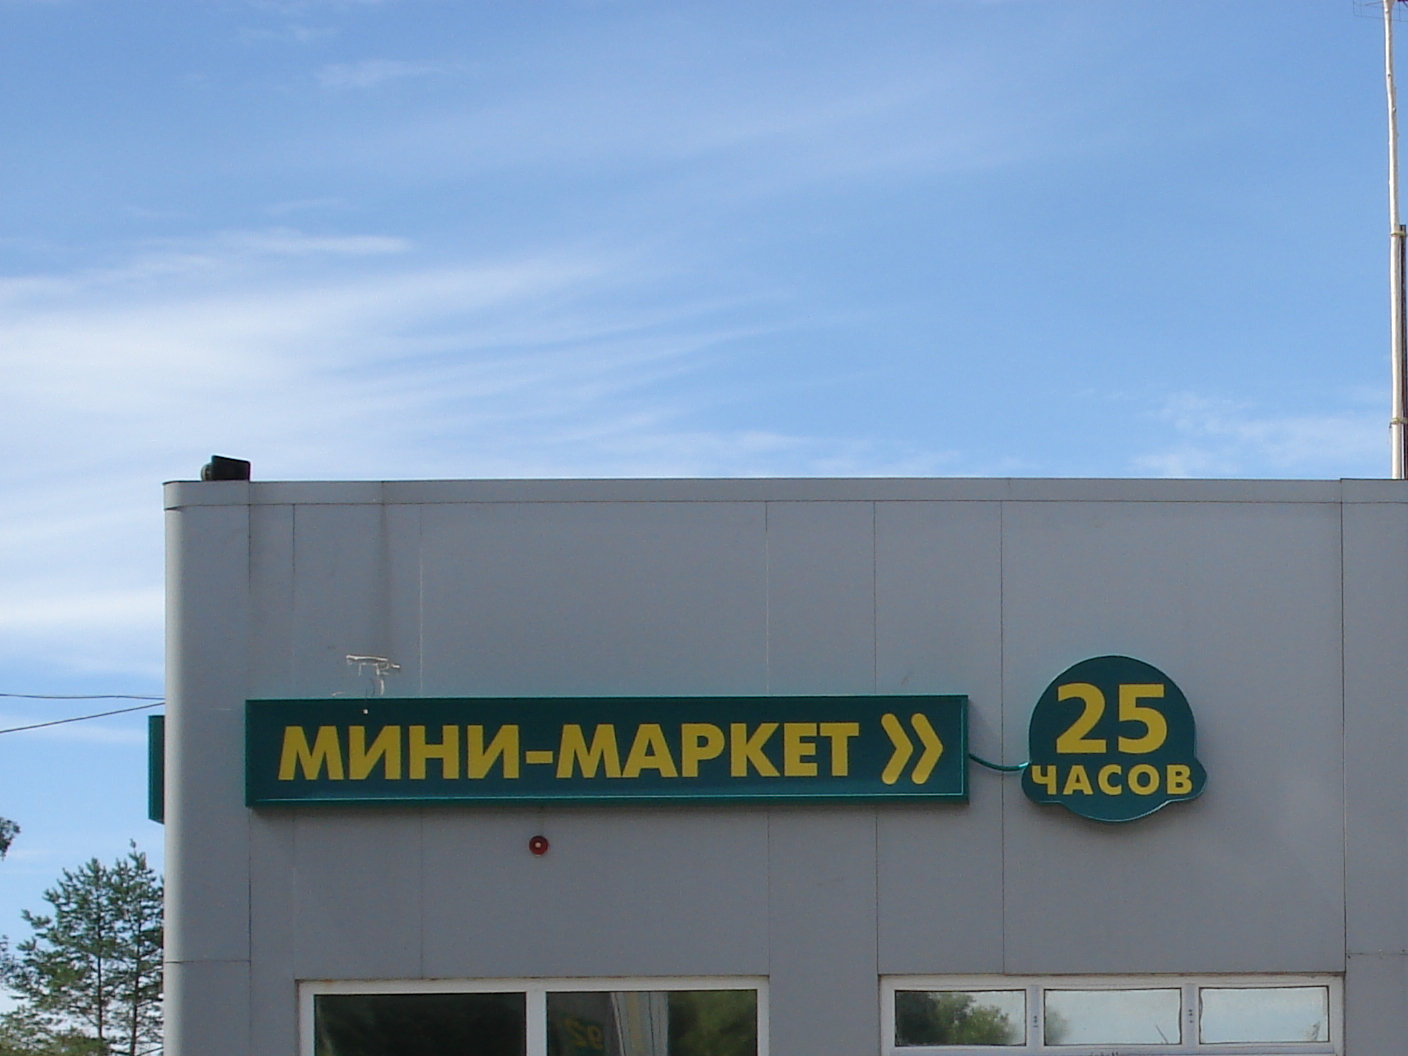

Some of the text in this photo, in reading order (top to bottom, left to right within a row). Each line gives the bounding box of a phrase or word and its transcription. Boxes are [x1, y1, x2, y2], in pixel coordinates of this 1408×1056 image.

[1056, 682, 1168, 754] 25
[278, 722, 860, 781] МИНИ-МАРКЕТ
[1031, 763, 1193, 796] ЧАСОВ
